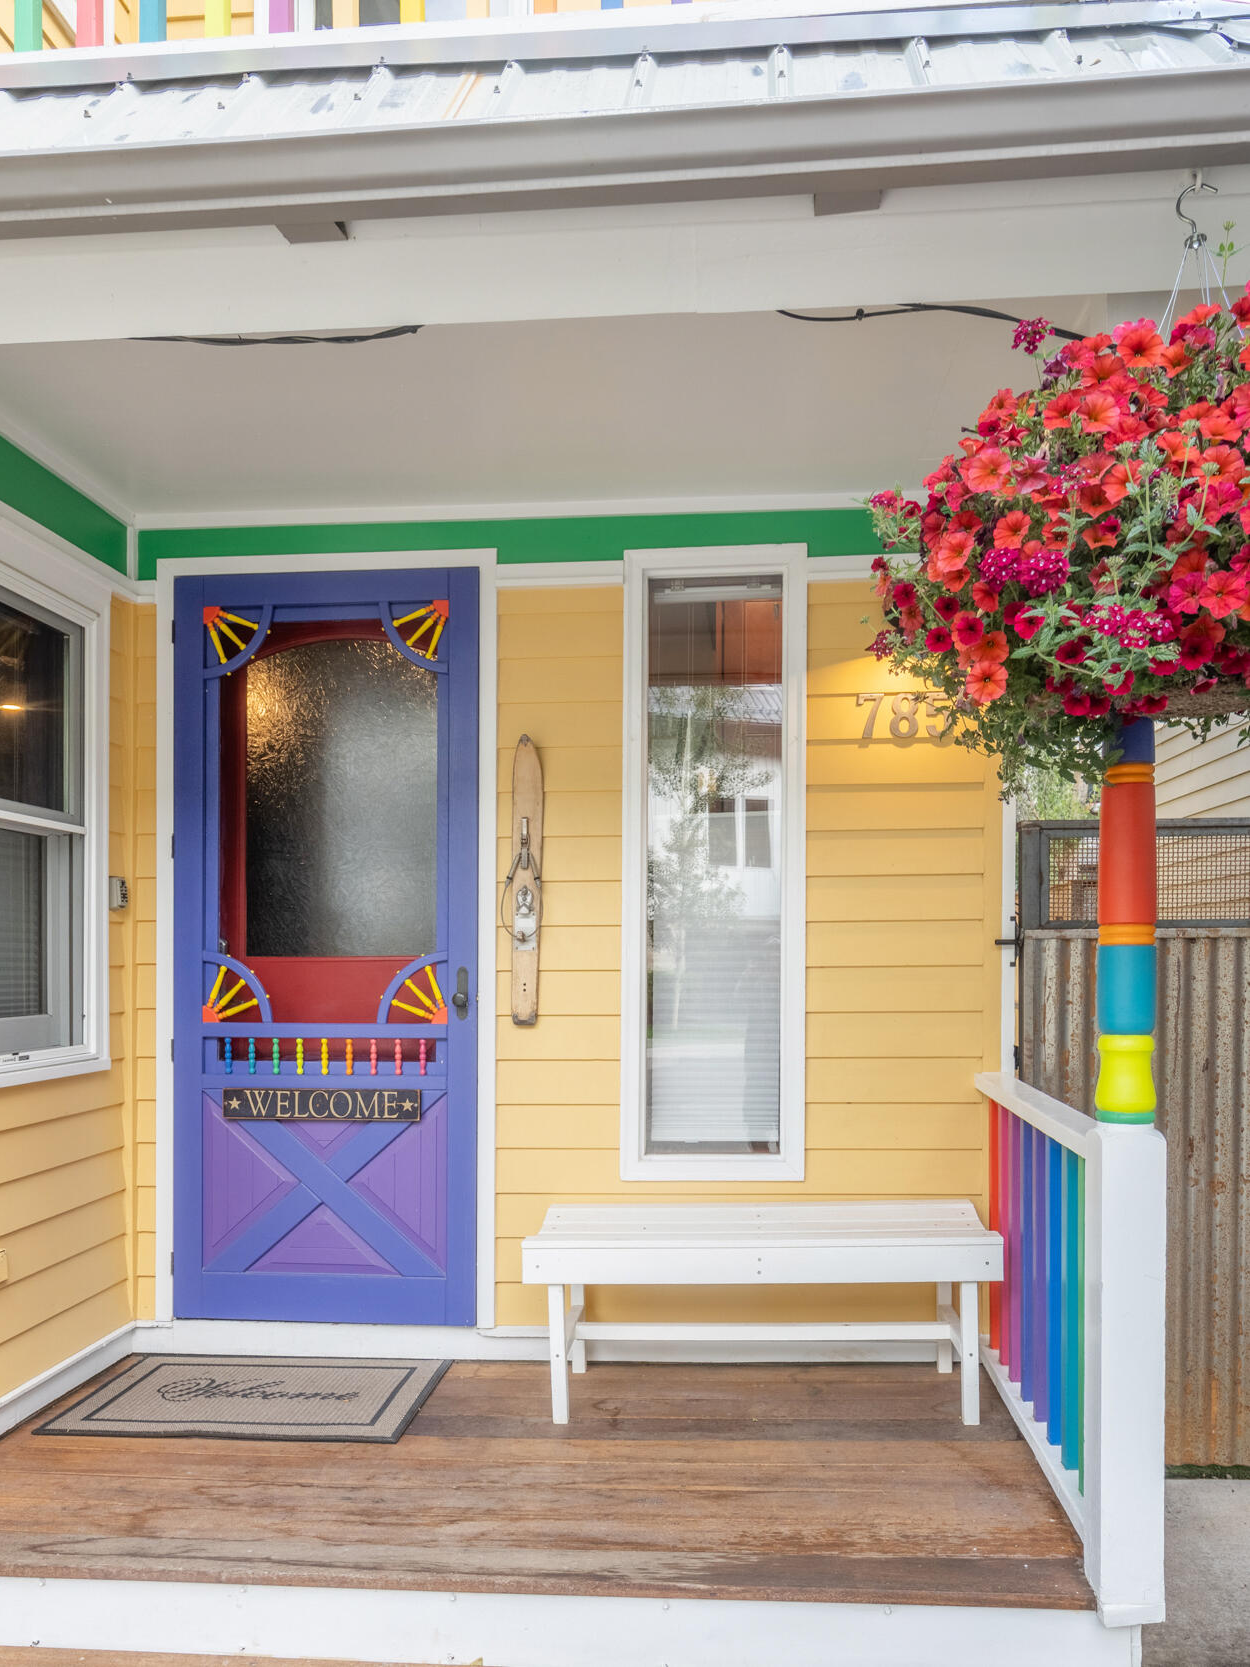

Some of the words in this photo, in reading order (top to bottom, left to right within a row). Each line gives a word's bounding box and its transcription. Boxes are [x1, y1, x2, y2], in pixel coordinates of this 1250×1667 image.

[855, 693, 953, 739] 785
[244, 1089, 400, 1119] WELCOME
[157, 1377, 360, 1403] Welcome
